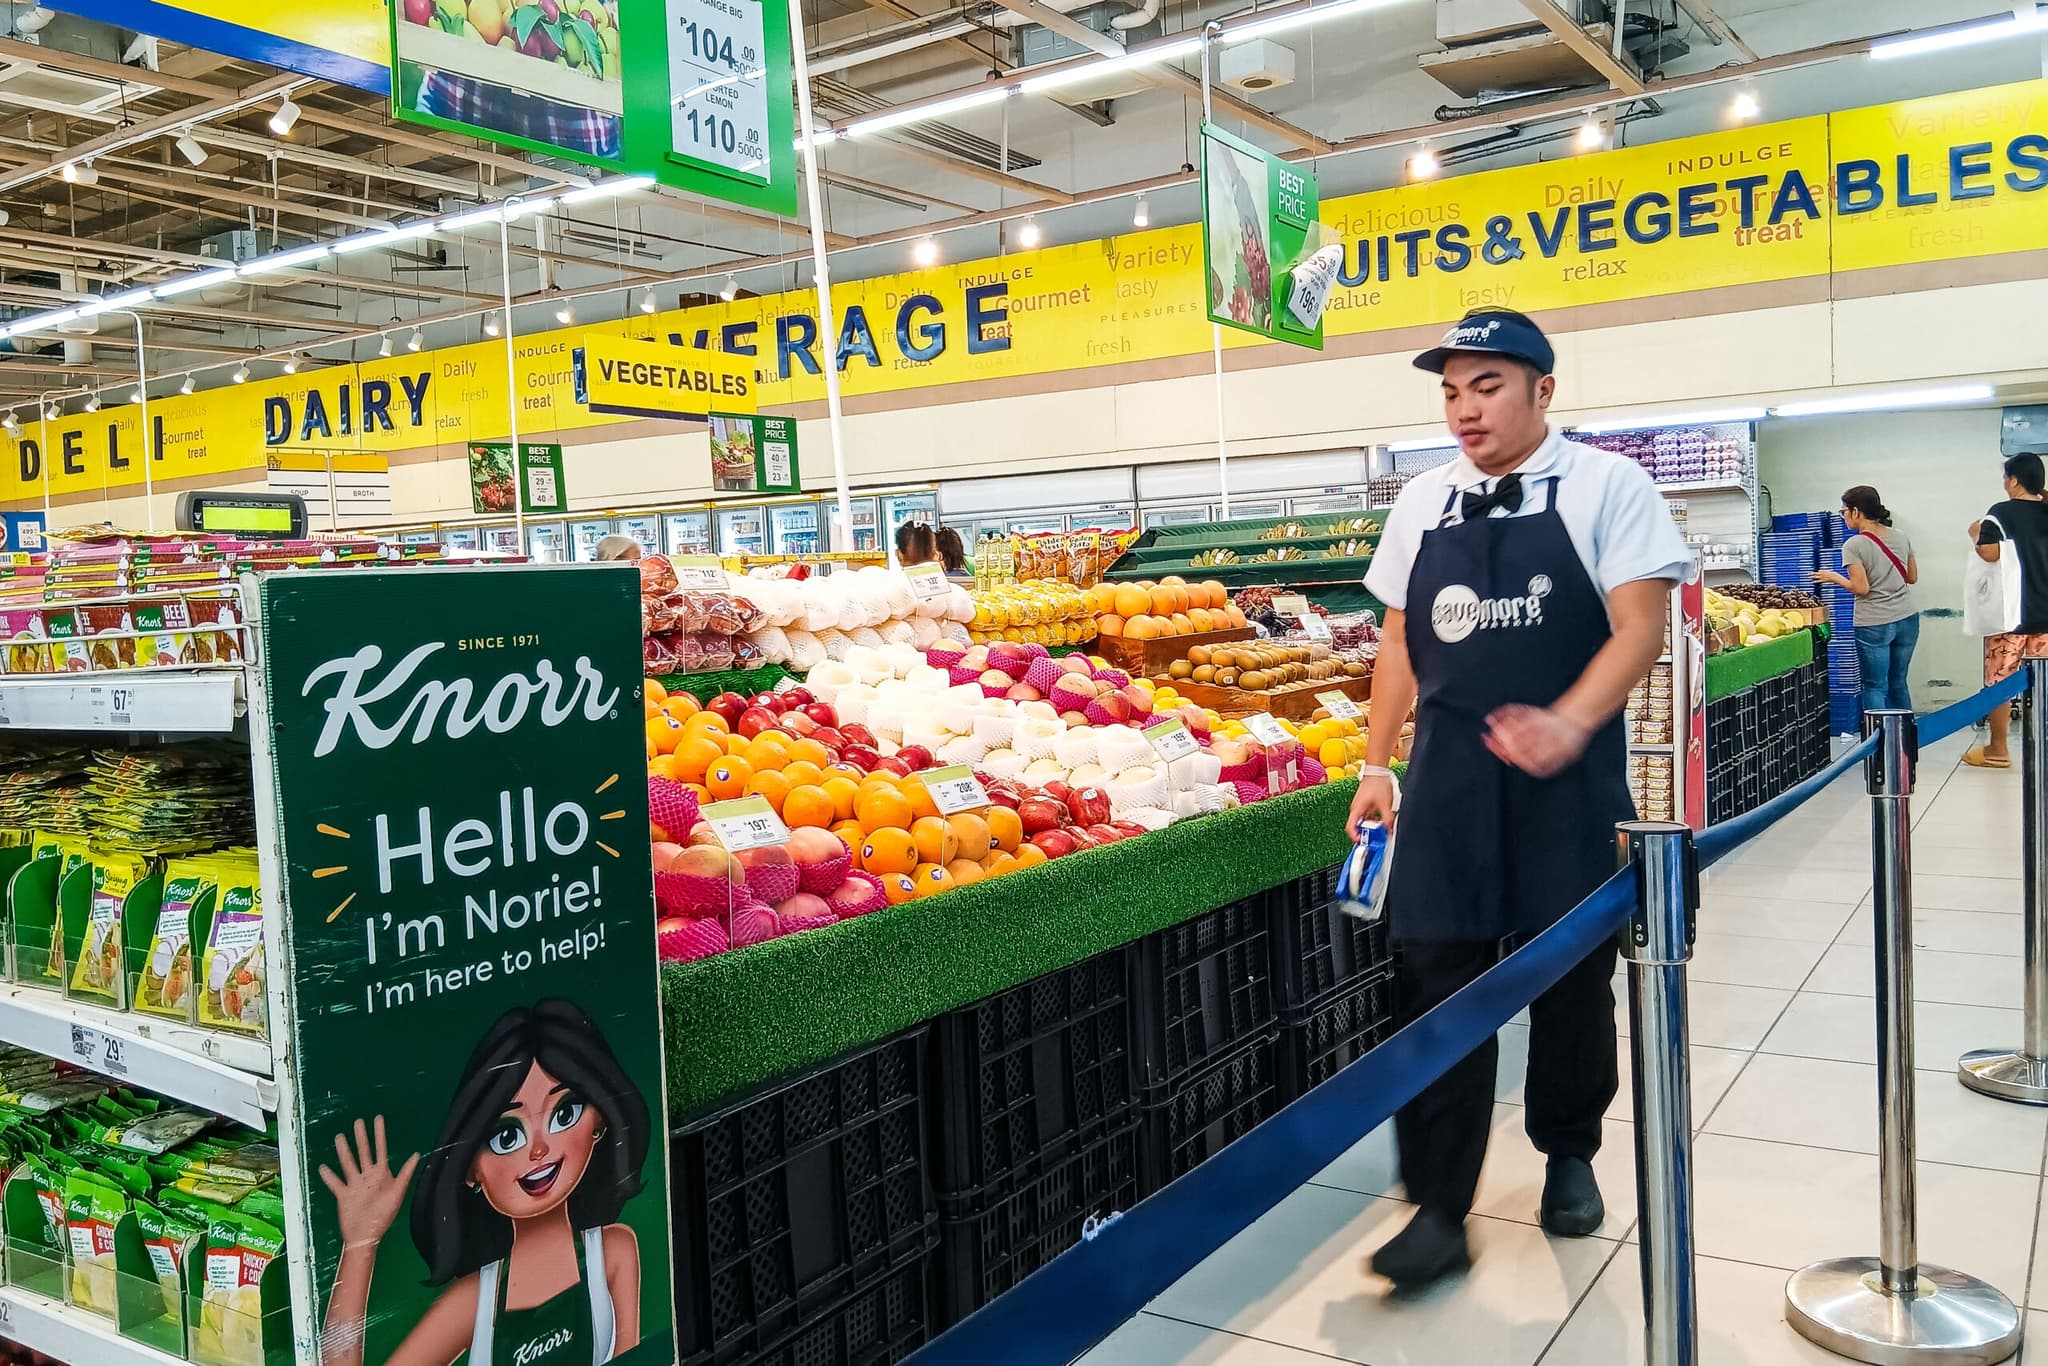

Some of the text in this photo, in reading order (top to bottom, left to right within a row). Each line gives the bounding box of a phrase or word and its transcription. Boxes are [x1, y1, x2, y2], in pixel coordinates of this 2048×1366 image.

[729, 5, 744, 19] BIG
[705, 92, 734, 110] LEMON
[737, 142, 763, 160] 500G
[1667, 143, 1793, 176] INDULGE
[1279, 168, 1305, 197] BEST
[1544, 176, 1625, 209] Daily
[1278, 191, 1307, 220] PRICE
[1335, 134, 2048, 287] UITS&VEGETABLES
[1334, 202, 1461, 238] delicious
[1733, 217, 1804, 247] treat
[1107, 242, 1194, 272] Variety
[958, 266, 1033, 289] INDULGE
[1562, 258, 1628, 282] relax
[1116, 278, 1158, 299] tasty
[1459, 282, 1515, 307] tasty
[1324, 289, 1381, 312] value
[1100, 302, 1198, 323] PLEASURES
[979, 321, 1013, 341] reat
[513, 343, 566, 360] INDULGE
[1087, 336, 1131, 356] fresh
[443, 359, 477, 378] Daily
[598, 357, 748, 397] VEGETABLES
[461, 387, 489, 402] fresh
[523, 393, 552, 411] treat
[264, 372, 432, 446] DAIRY
[434, 414, 462, 429] relax
[764, 419, 786, 429] BEST
[161, 427, 204, 446] Gourmet
[764, 429, 787, 439] PRICE
[18, 415, 164, 482] DELI
[187, 446, 207, 460] treat
[528, 446, 550, 455] BEST
[528, 455, 552, 464] PRICE
[535, 477, 545, 486] 29
[352, 490, 375, 498] BROTH
[536, 494, 546, 503] 40
[50, 623, 73, 635] Knorr
[135, 615, 163, 628] Knorr
[458, 634, 541, 651] SINCE 1971
[113, 689, 127, 711] 67
[301, 641, 620, 757] Knorr
[748, 818, 767, 832] 197
[375, 786, 590, 894] Hello
[167, 883, 195, 897] Knorr
[224, 891, 253, 907] Knorr
[366, 865, 602, 965] I'm Norie!
[367, 922, 606, 1013] I'm here to help!
[104, 1037, 119, 1061] 29
[212, 1226, 236, 1242] Knorr
[243, 1251, 267, 1271] CHICKE
[0, 1301, 9, 1322] 2
[512, 1328, 574, 1366] Knorr
